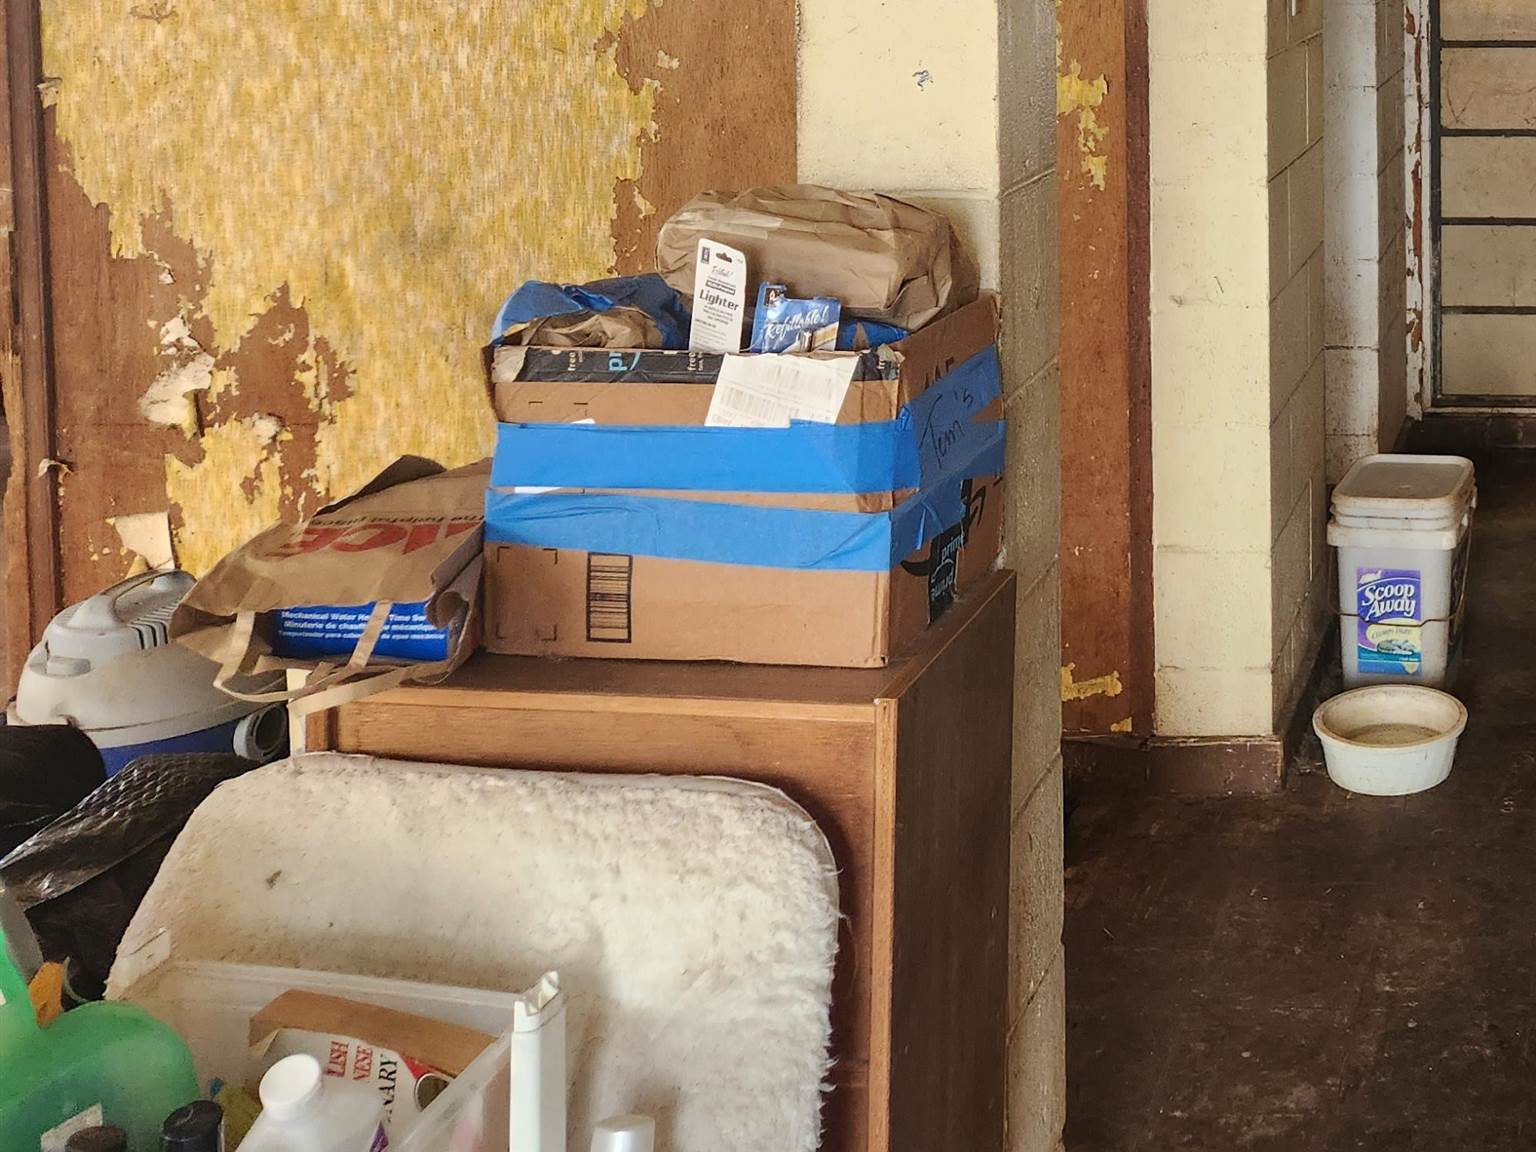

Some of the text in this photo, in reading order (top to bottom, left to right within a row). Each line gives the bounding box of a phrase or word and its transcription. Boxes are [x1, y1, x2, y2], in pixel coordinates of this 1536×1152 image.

[699, 289, 739, 311] Lighter
[766, 305, 829, 339] Refillable!
[1362, 584, 1415, 605] Scoop
[1365, 598, 1416, 621] Away
